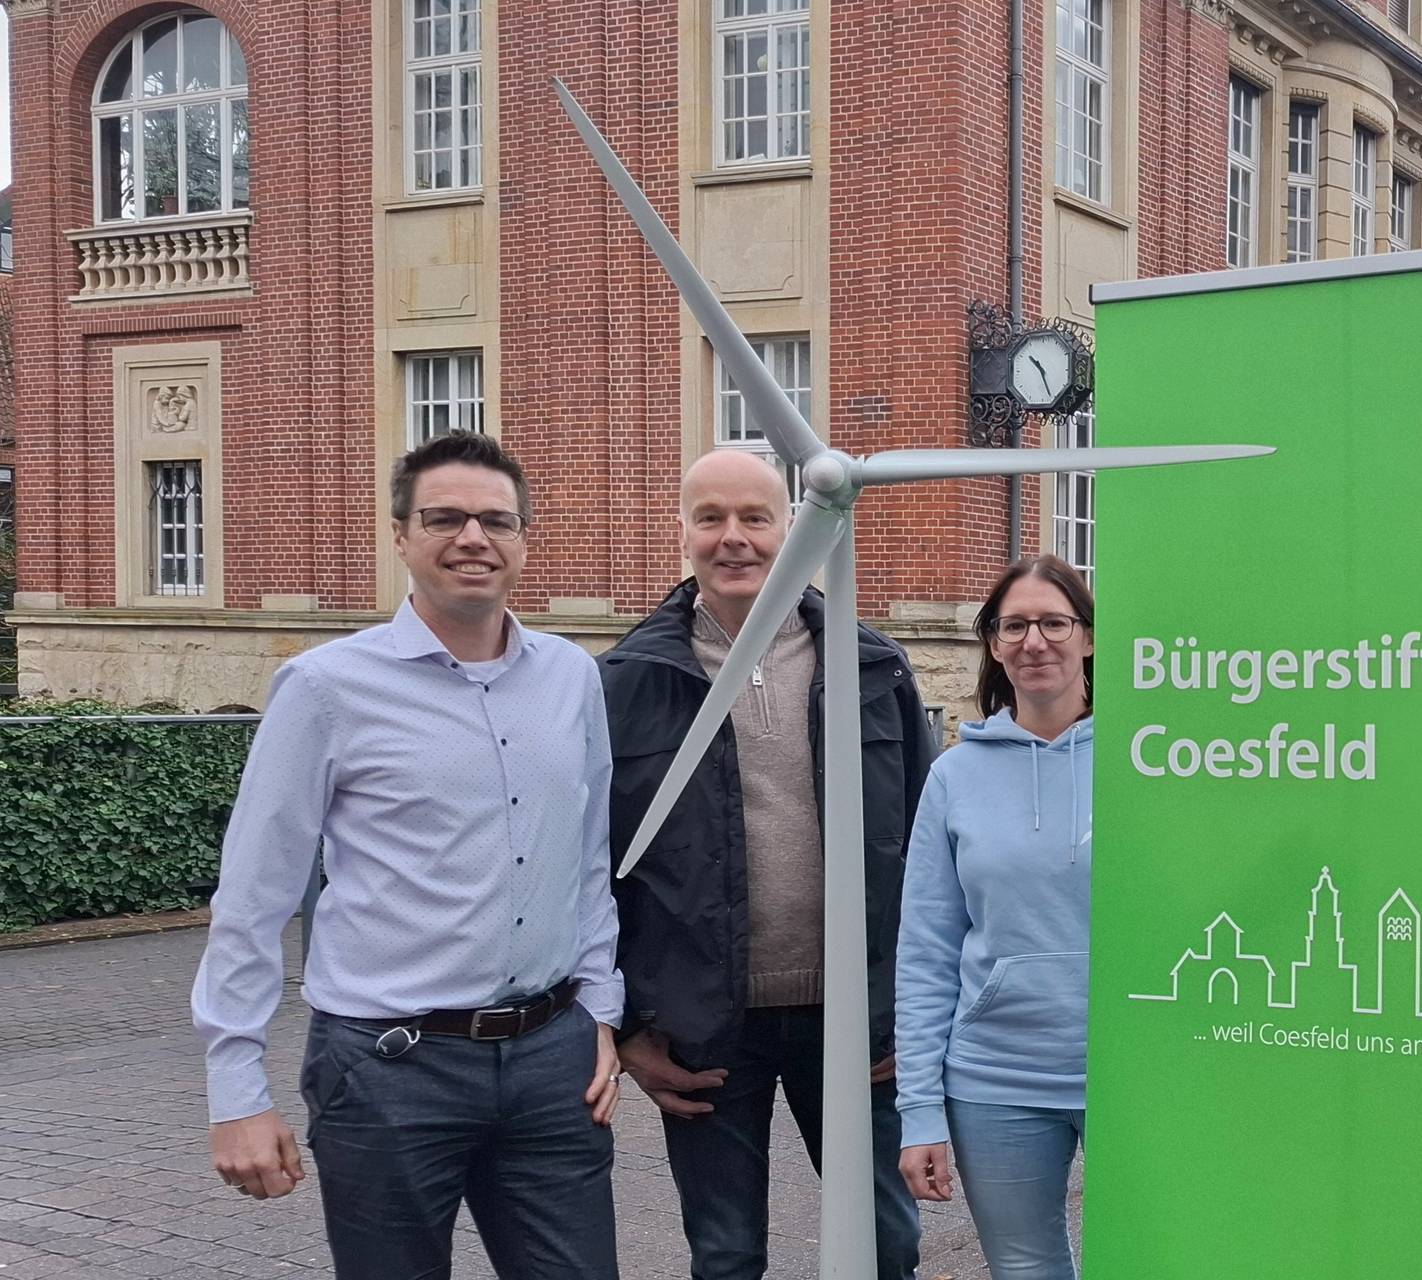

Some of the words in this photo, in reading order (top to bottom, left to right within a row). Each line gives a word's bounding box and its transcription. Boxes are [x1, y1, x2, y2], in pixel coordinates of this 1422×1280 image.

[1131, 723, 1376, 780] Coesfeld
[1212, 1021, 1253, 1043] weil
[1259, 1022, 1350, 1051] Coesfeld
[1356, 1035, 1394, 1054] uns
